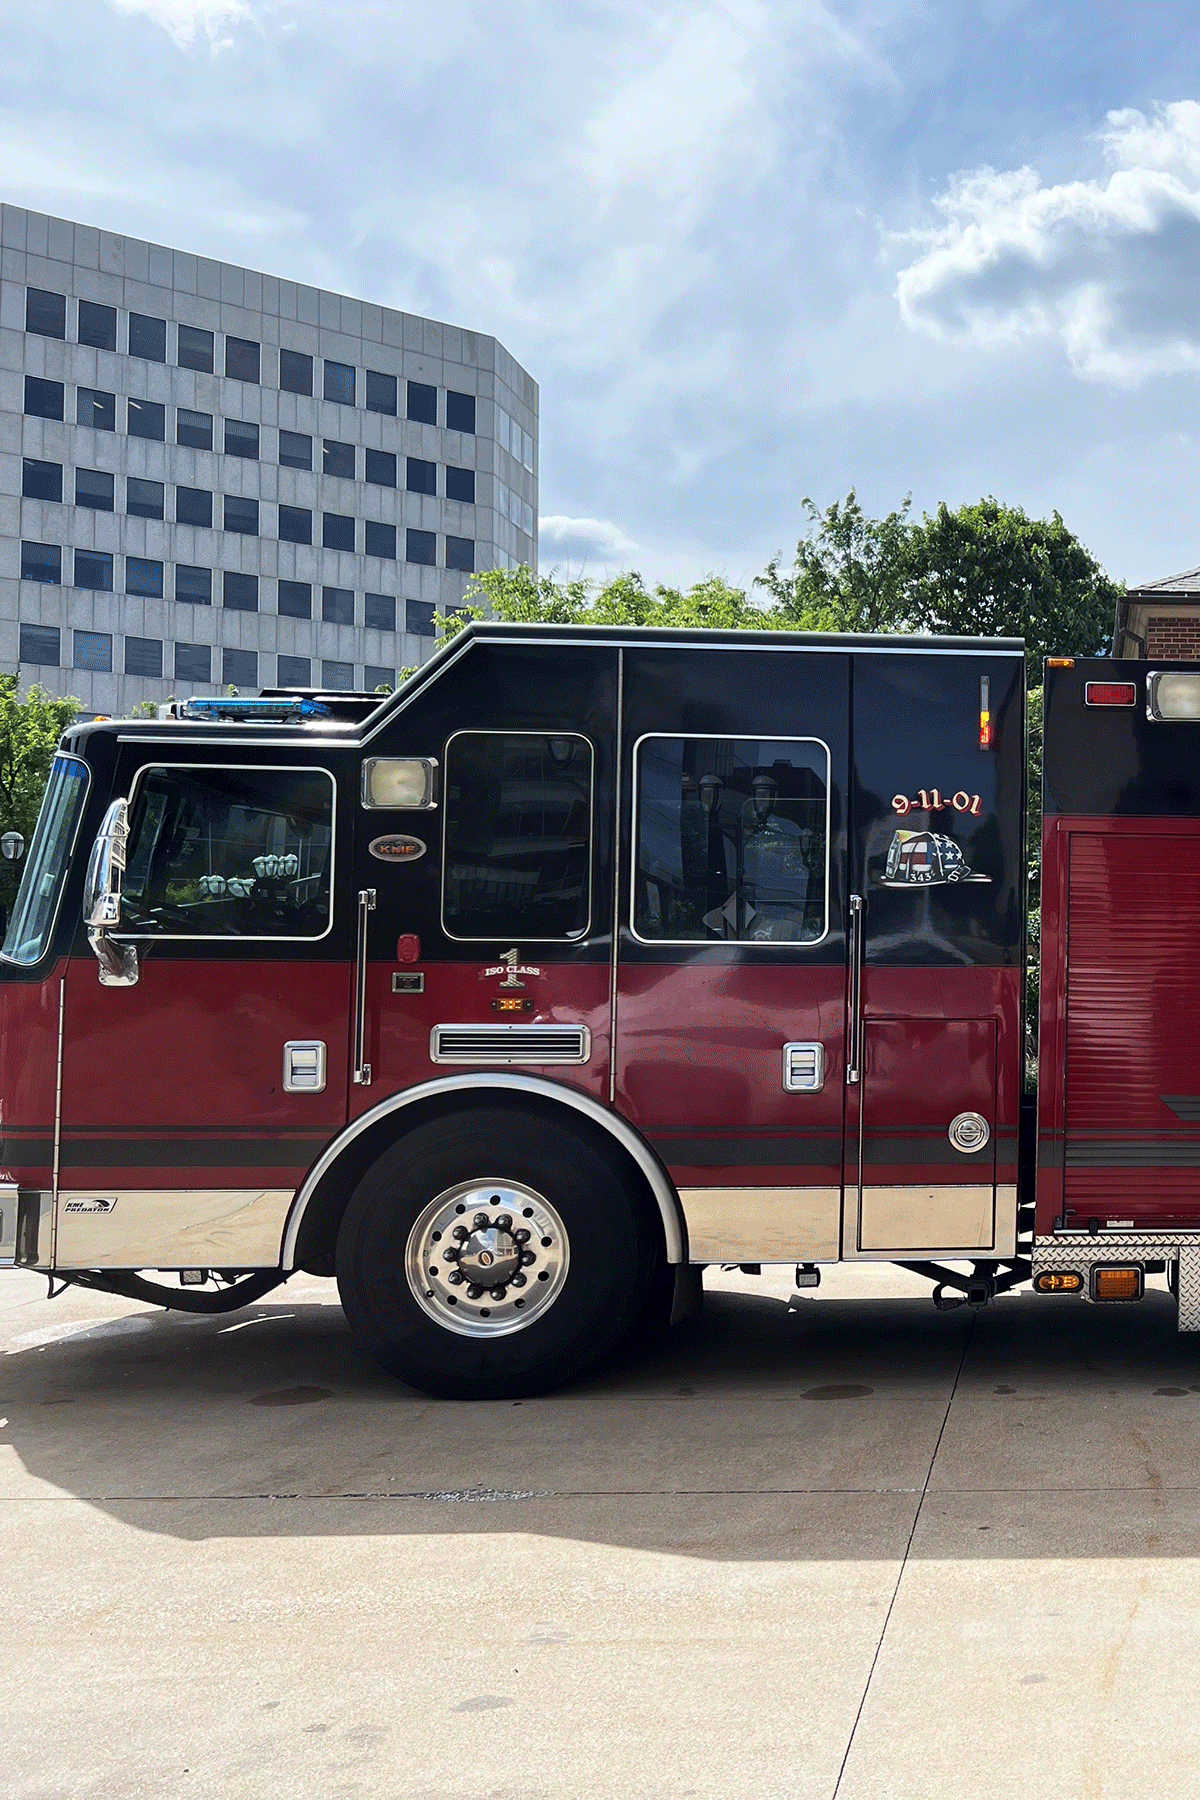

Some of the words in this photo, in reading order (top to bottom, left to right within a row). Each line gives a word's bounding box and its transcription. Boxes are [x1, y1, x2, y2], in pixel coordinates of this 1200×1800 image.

[891, 788, 982, 816] 9-11-01
[380, 845, 416, 854] KME
[909, 872, 932, 882] 343
[485, 966, 504, 976] ISO
[506, 965, 540, 975] CLASS
[499, 947, 526, 987] 1
